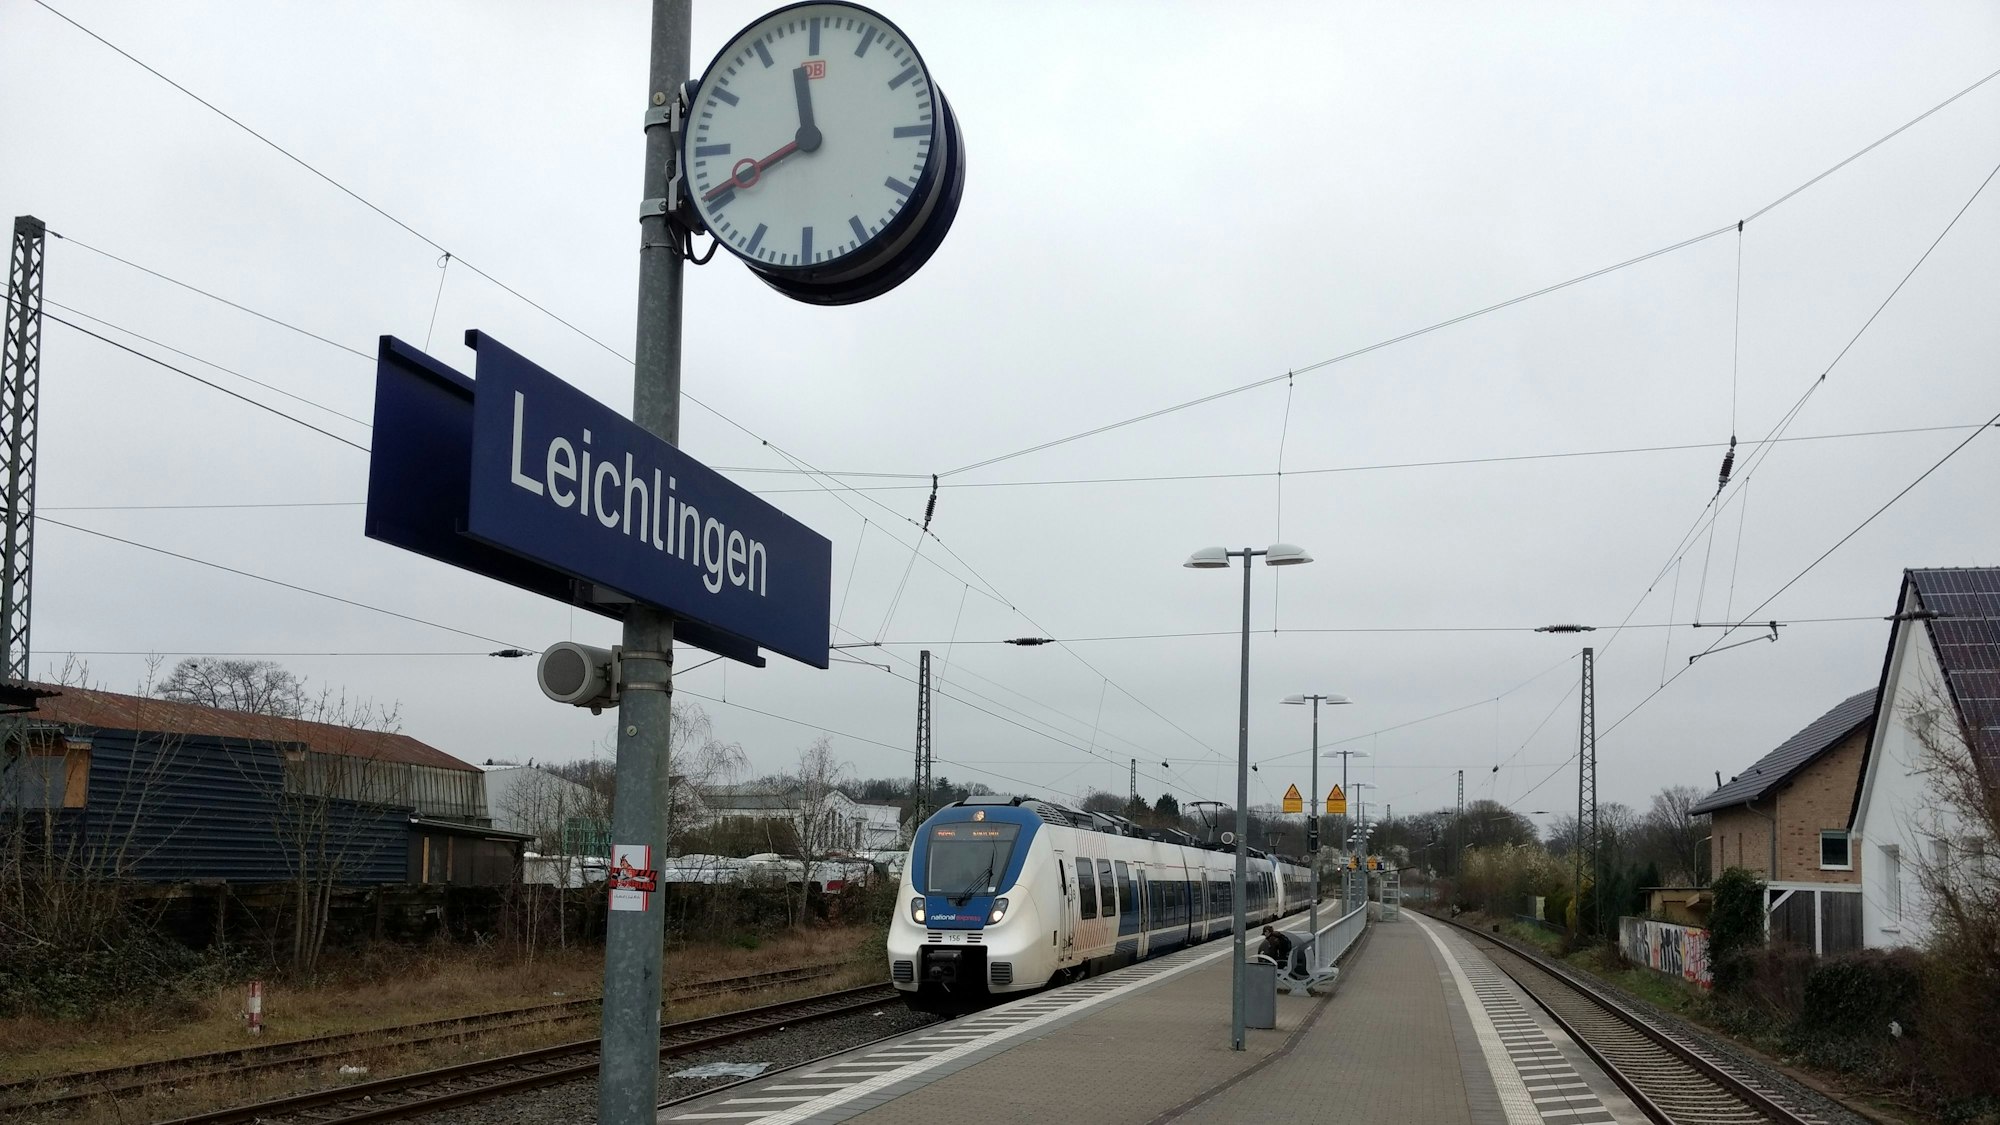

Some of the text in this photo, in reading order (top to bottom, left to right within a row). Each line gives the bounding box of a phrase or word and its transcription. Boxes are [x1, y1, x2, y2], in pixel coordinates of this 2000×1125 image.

[803, 62, 824, 77] DB
[511, 390, 767, 597] Leichlingen
[930, 913, 981, 923] national express
[949, 934, 961, 942] 156
